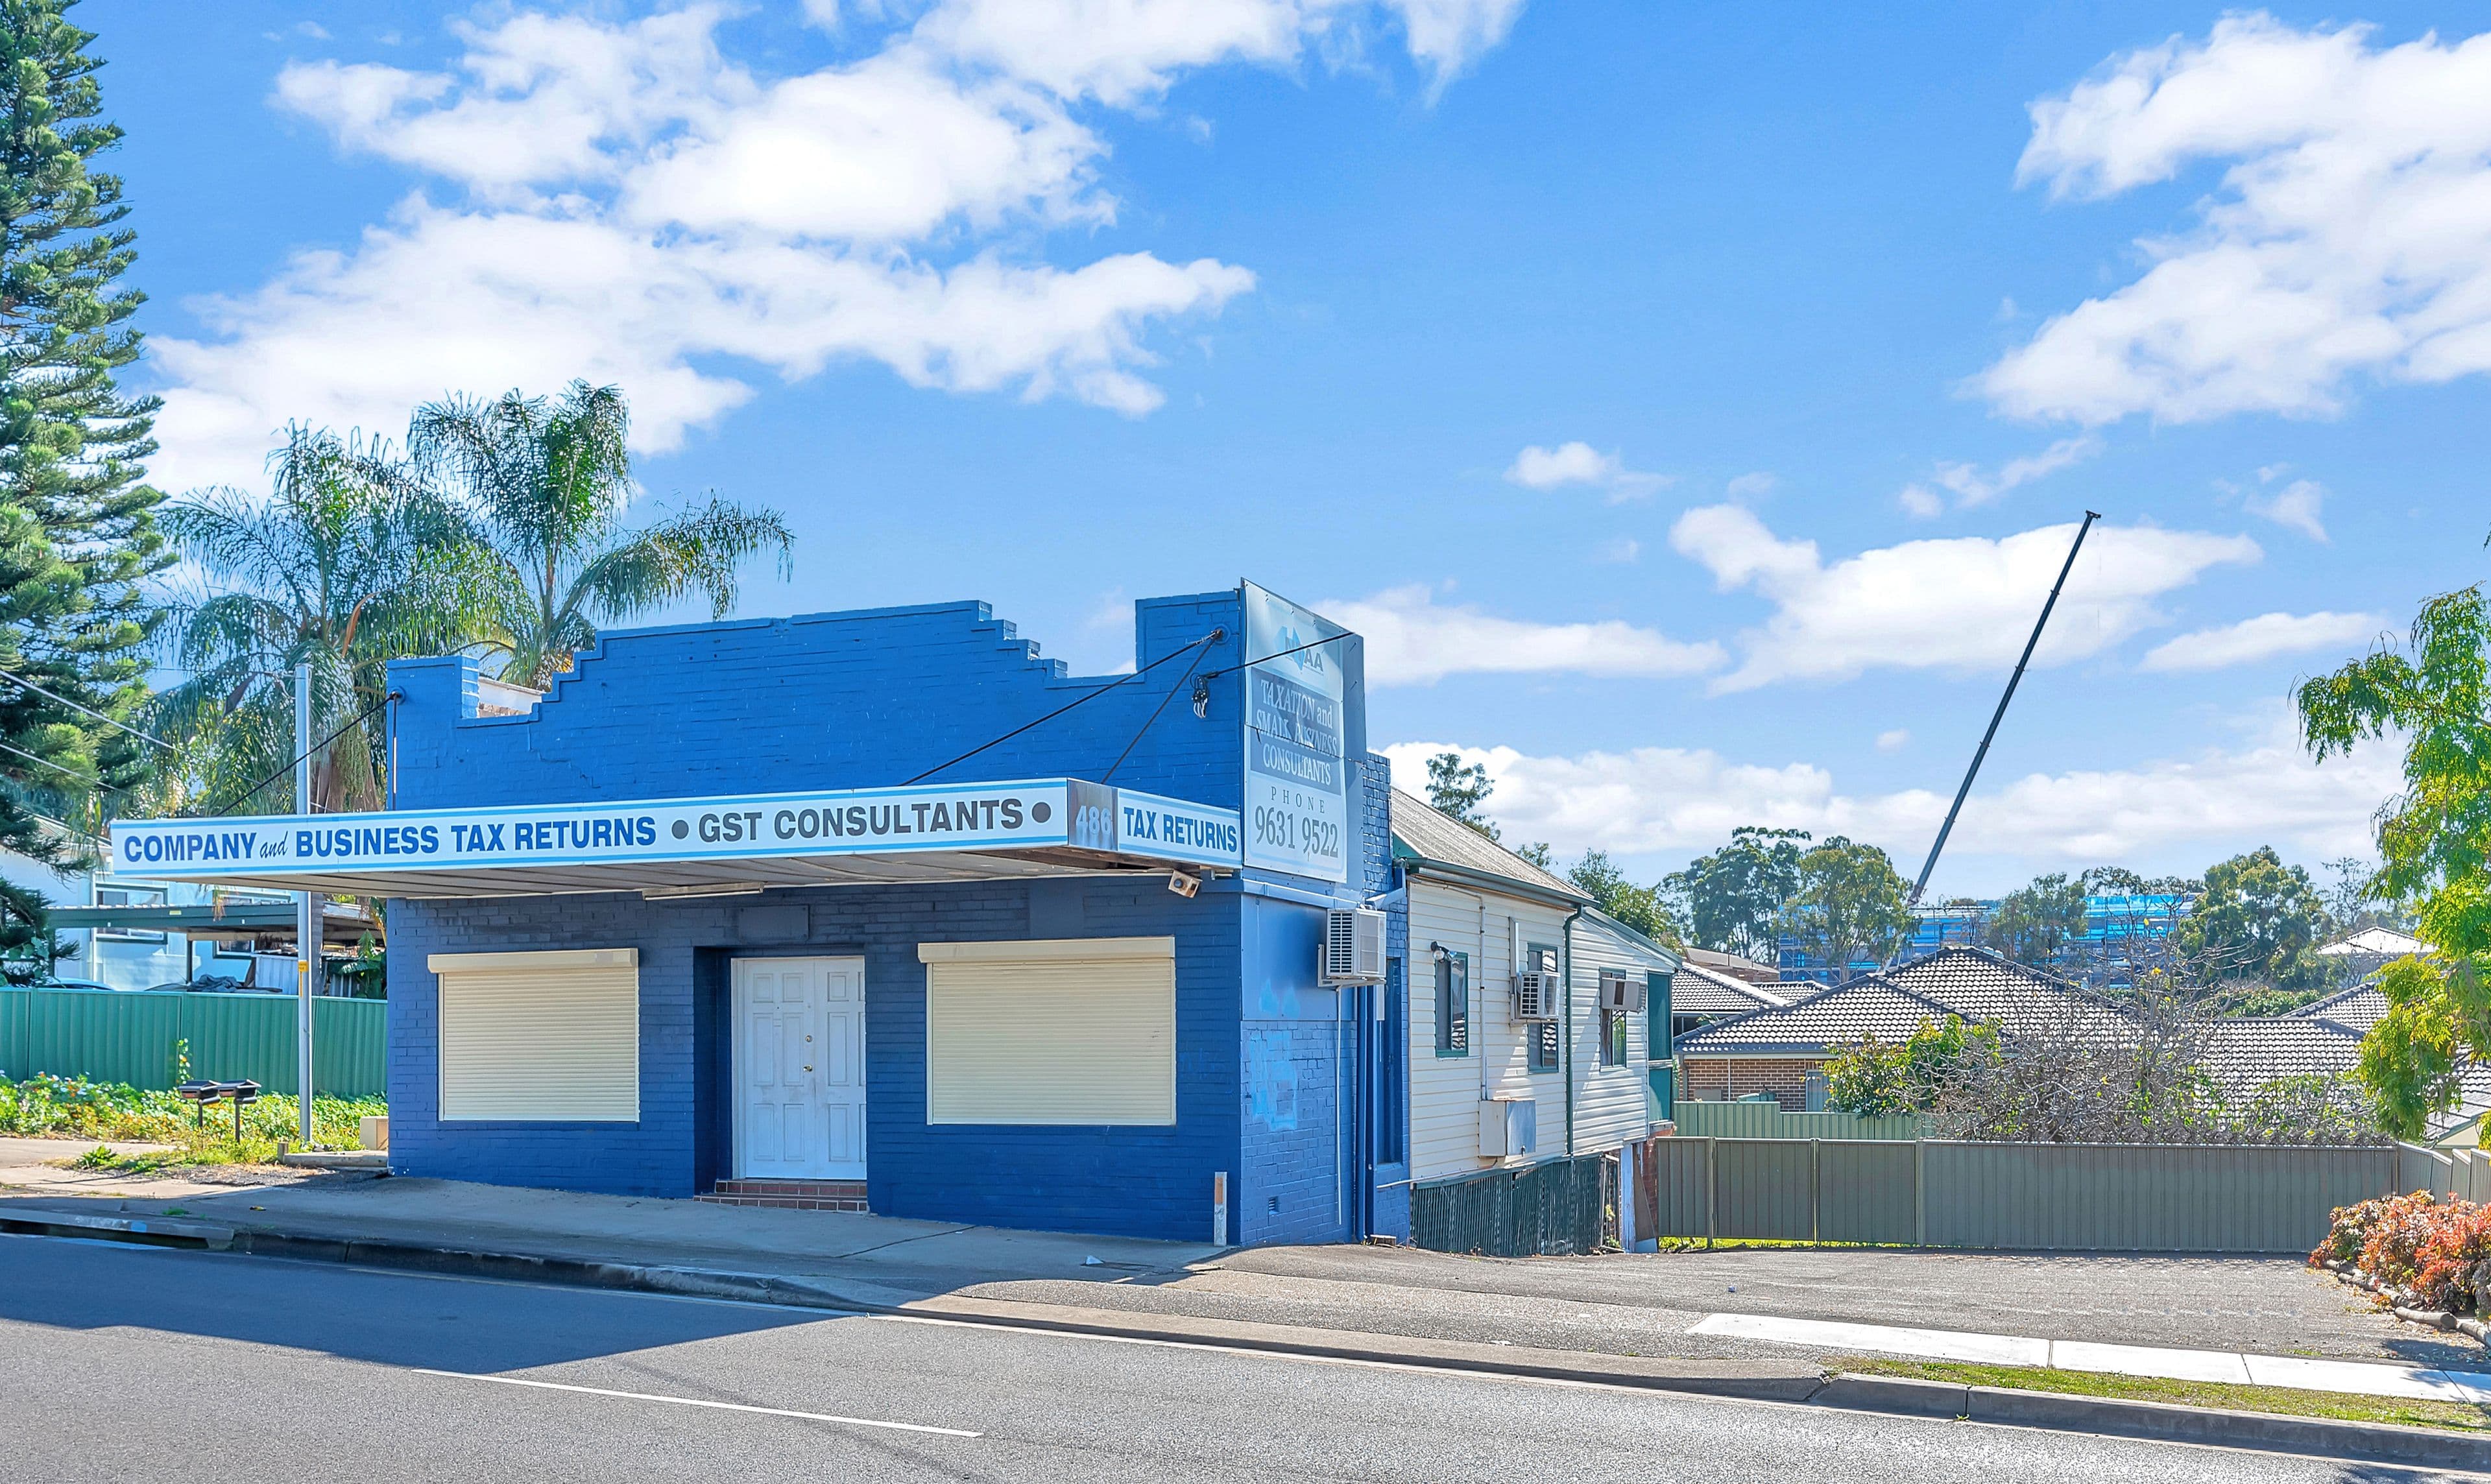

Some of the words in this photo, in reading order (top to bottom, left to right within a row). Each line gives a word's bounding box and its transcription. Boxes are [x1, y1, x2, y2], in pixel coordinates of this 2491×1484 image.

[1257, 710, 1292, 743] SMALL
[1260, 680, 1315, 722] TAXATION
[1317, 706, 1332, 730] and
[1263, 744, 1331, 785] CONSULTANTS
[1076, 806, 1111, 835] 486
[1271, 786, 1325, 813] PHONE
[124, 833, 257, 862] COMPANY
[259, 831, 288, 859] and
[296, 826, 439, 857] BUSINESS
[451, 823, 505, 852] TAX
[515, 817, 656, 850] RETURNS
[698, 812, 762, 842] GST
[774, 798, 1023, 839] CONSULTANTS
[1124, 807, 1158, 840] TAX
[1164, 814, 1237, 852] RETURNS
[1255, 805, 1295, 849] 9631
[1302, 817, 1338, 858] 9522
